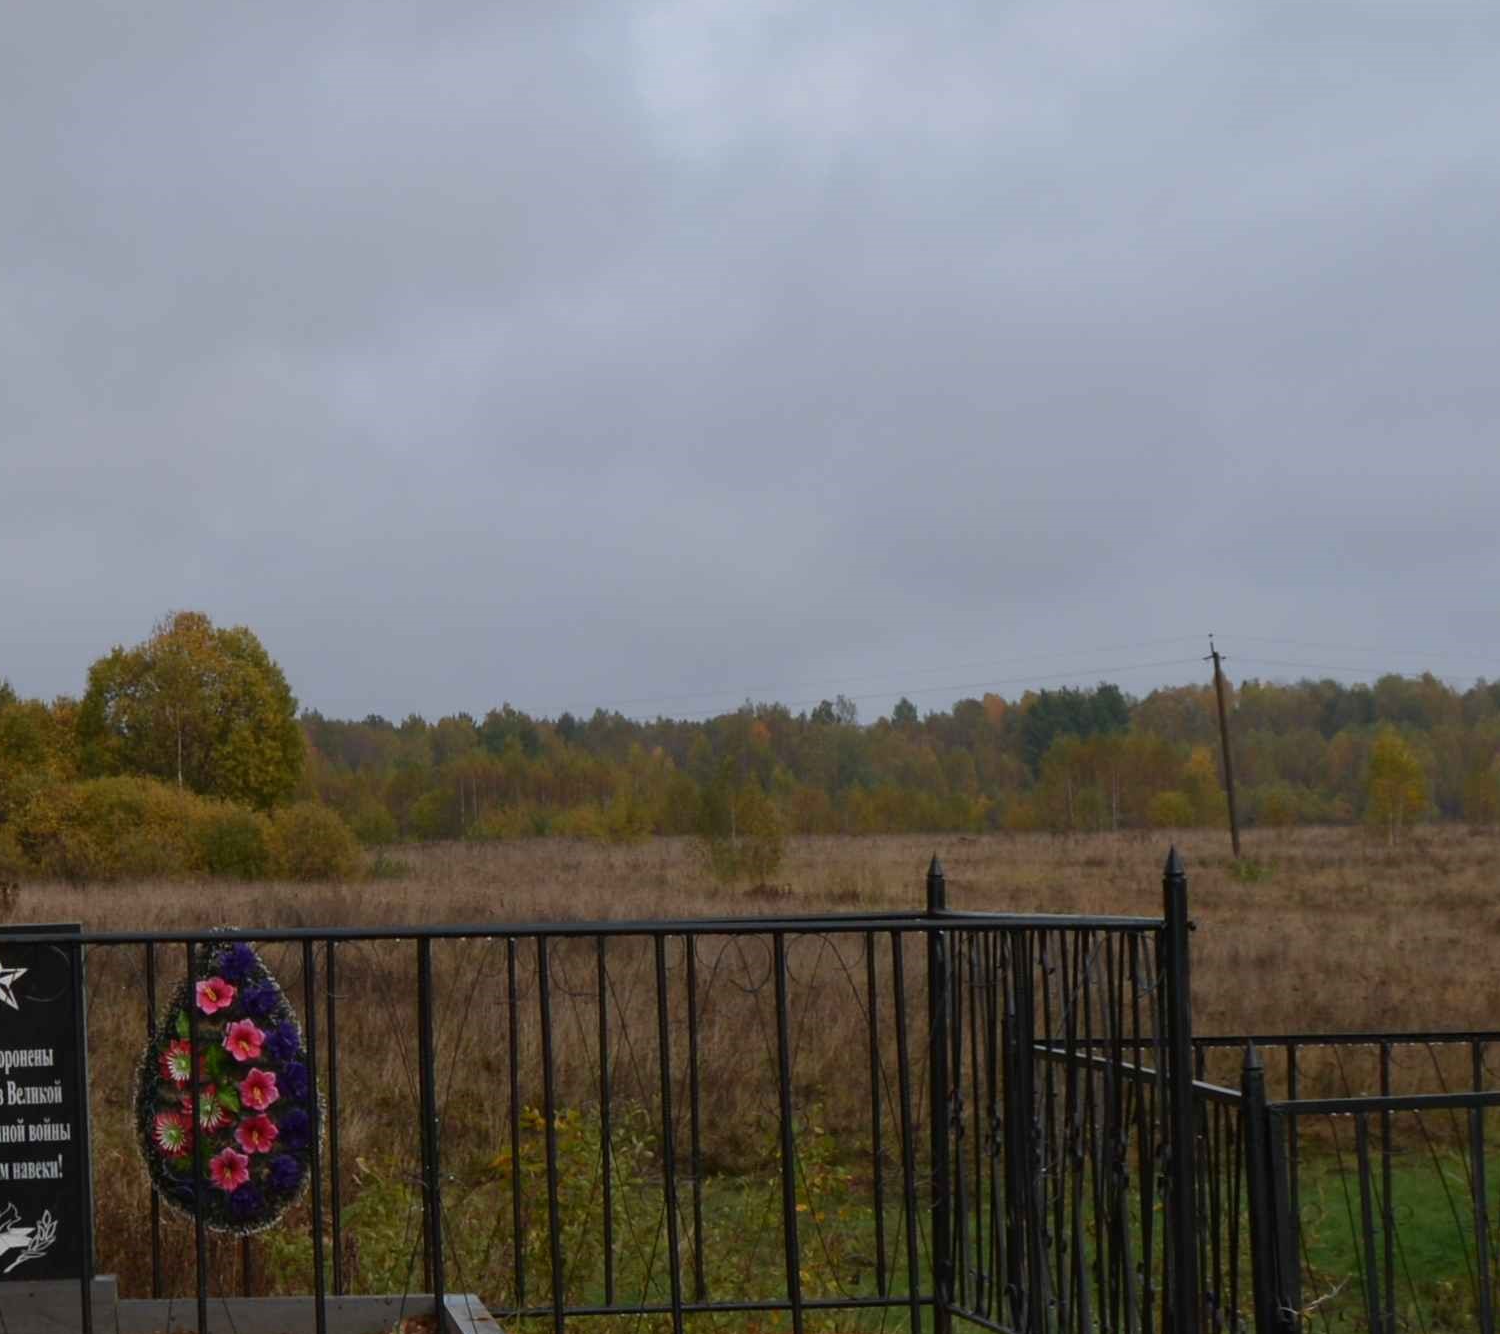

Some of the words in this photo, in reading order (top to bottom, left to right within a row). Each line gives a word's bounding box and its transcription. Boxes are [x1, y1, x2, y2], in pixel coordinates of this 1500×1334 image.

[6, 1078, 64, 1106] Великой
[28, 1116, 72, 1142] войны
[12, 1152, 65, 1180] навеки!
